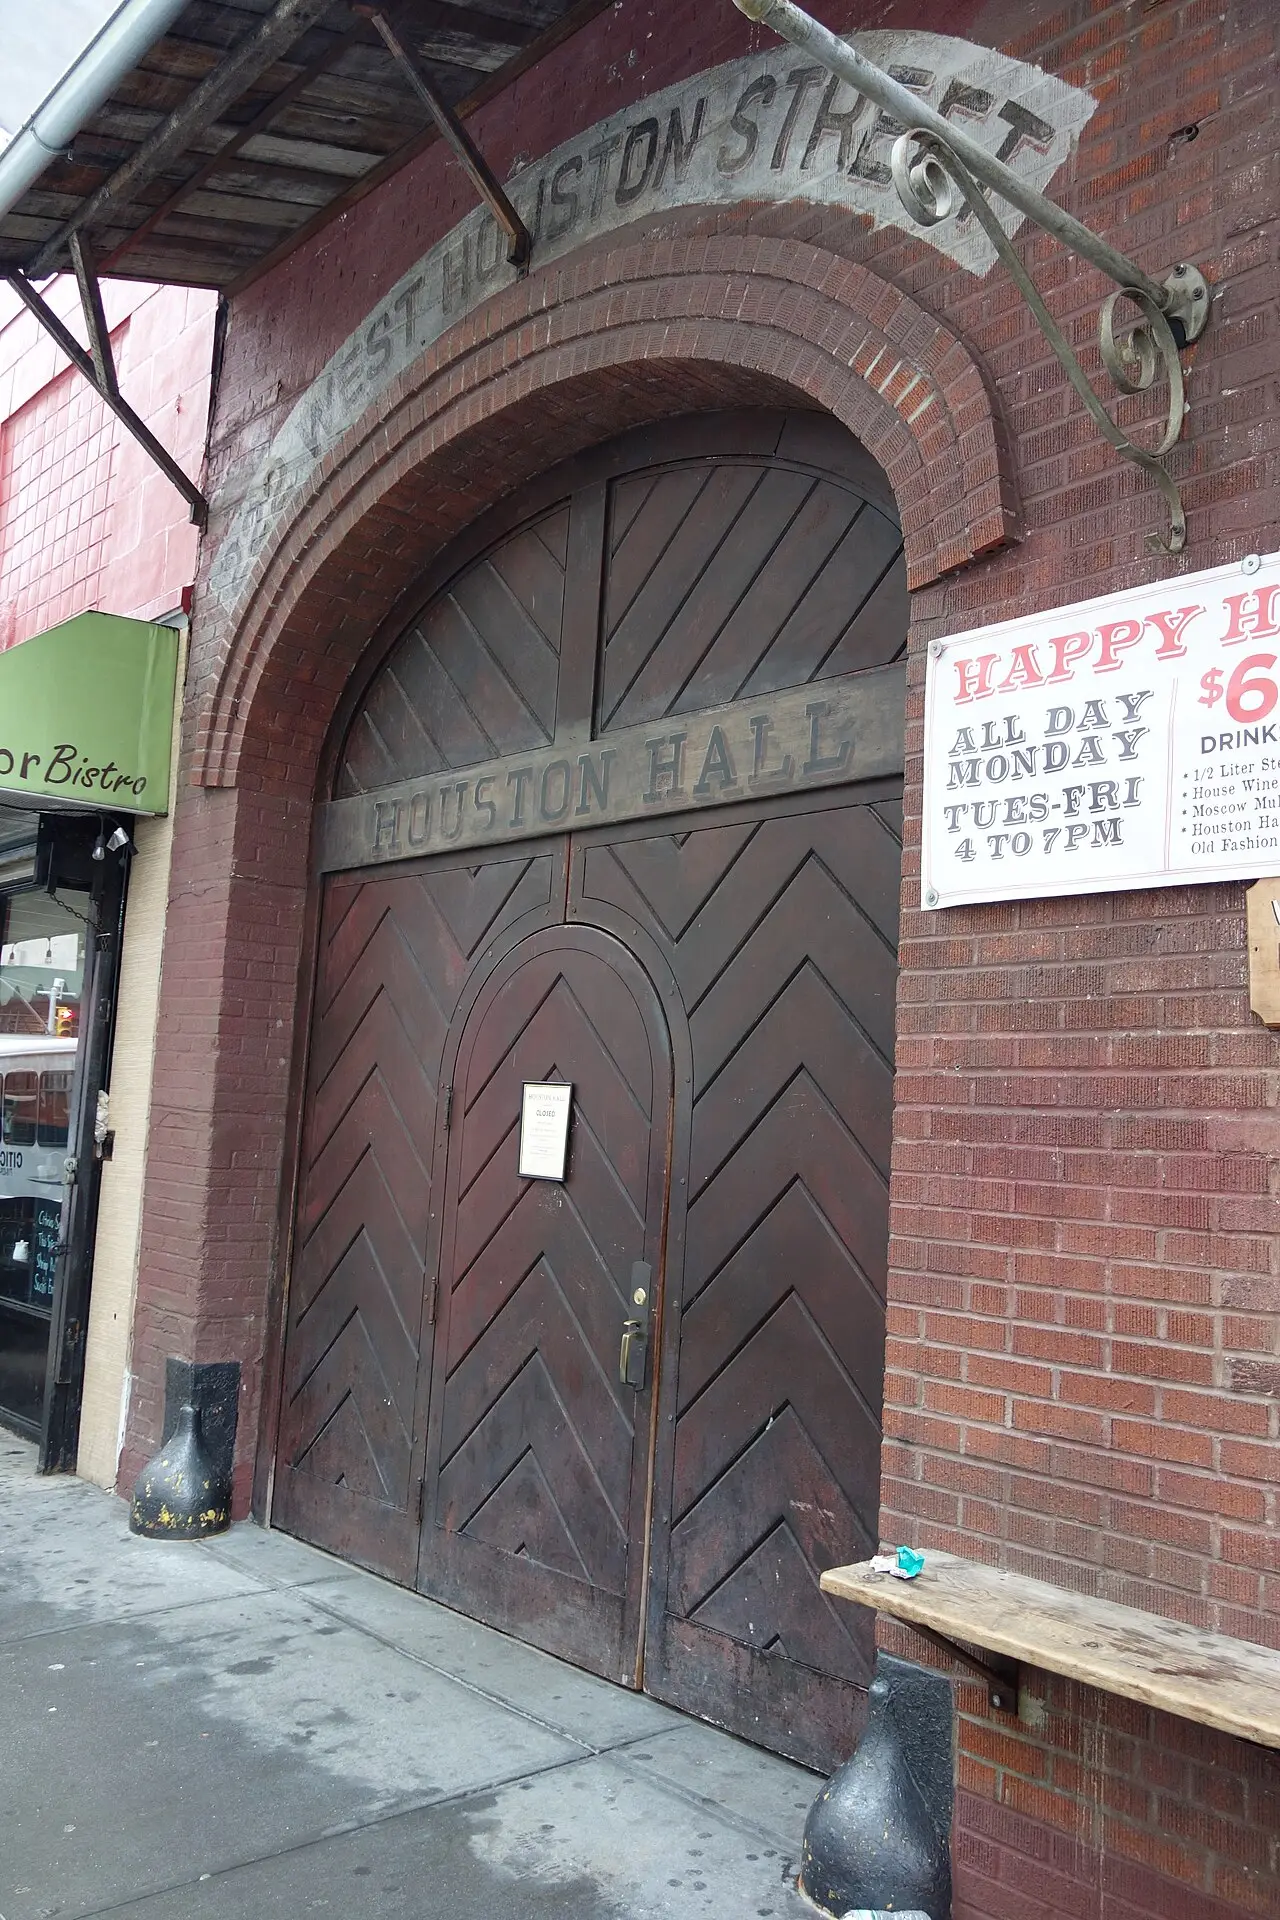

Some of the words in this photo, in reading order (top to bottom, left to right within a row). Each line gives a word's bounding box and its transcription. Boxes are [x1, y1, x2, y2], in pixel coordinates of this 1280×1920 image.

[953, 604, 1207, 705] HAPPY
[1197, 653, 1279, 722] $6
[948, 714, 1027, 757] ALL
[1044, 690, 1154, 738] DAY
[1201, 723, 1280, 754] DRINK
[44, 744, 147, 795] Bistro
[371, 747, 617, 856] HOUSTON
[643, 700, 853, 803] HALL
[946, 727, 1150, 790] MONDAY
[1193, 767, 1214, 782] 1/2
[1220, 763, 1255, 778] Liter
[943, 776, 1145, 833] TUES-FRI
[1192, 785, 1236, 800] House
[1242, 777, 1279, 792] Wine
[1192, 801, 1247, 818] Moscow
[954, 838, 976, 862] 4
[987, 831, 1033, 860] TO
[1043, 817, 1124, 855] 7PM
[1191, 819, 1252, 837] Houston
[1191, 840, 1215, 855] Old
[1221, 835, 1278, 852] Fashion
[536, 1109, 556, 1118] CLOSED
